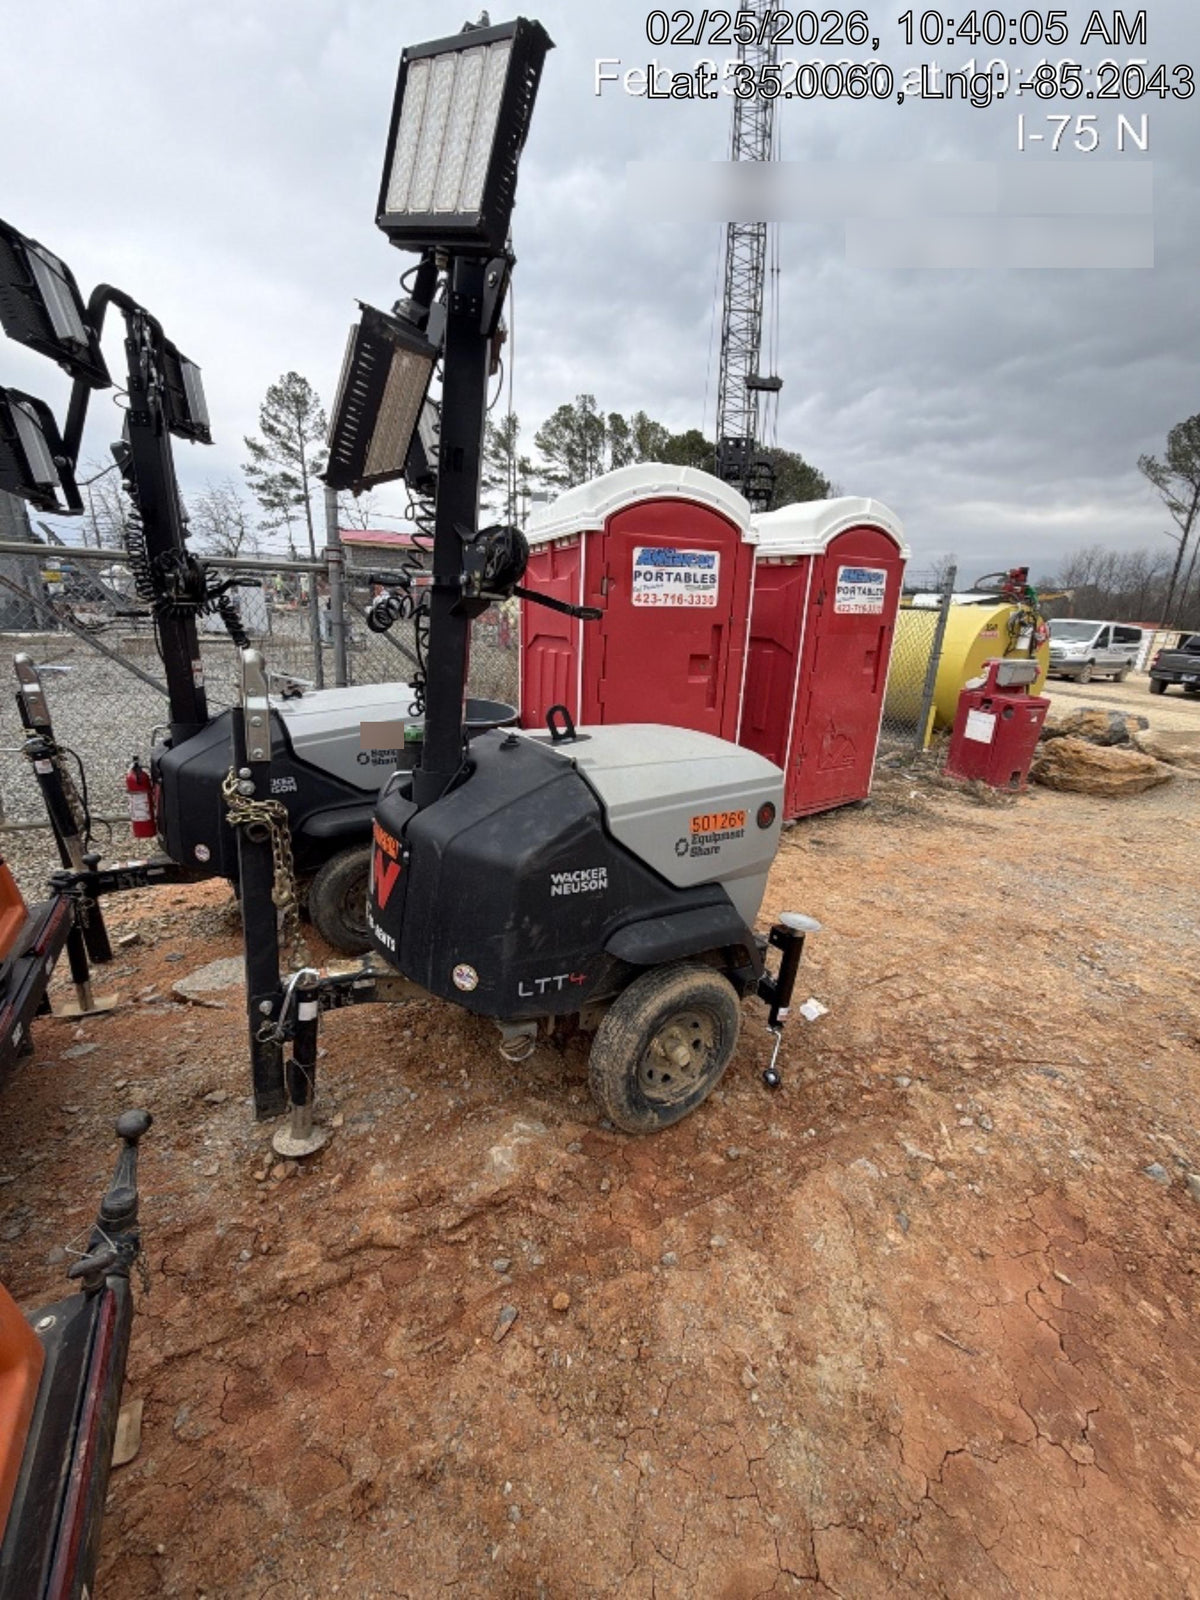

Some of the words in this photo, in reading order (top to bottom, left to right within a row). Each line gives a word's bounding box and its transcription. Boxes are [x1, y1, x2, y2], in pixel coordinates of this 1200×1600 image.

[634, 570, 717, 584] PORTABLES
[690, 845, 721, 857] Share
[550, 866, 607, 884] WACKER
[550, 878, 608, 897] NEUSON
[518, 972, 587, 997] LTT4
